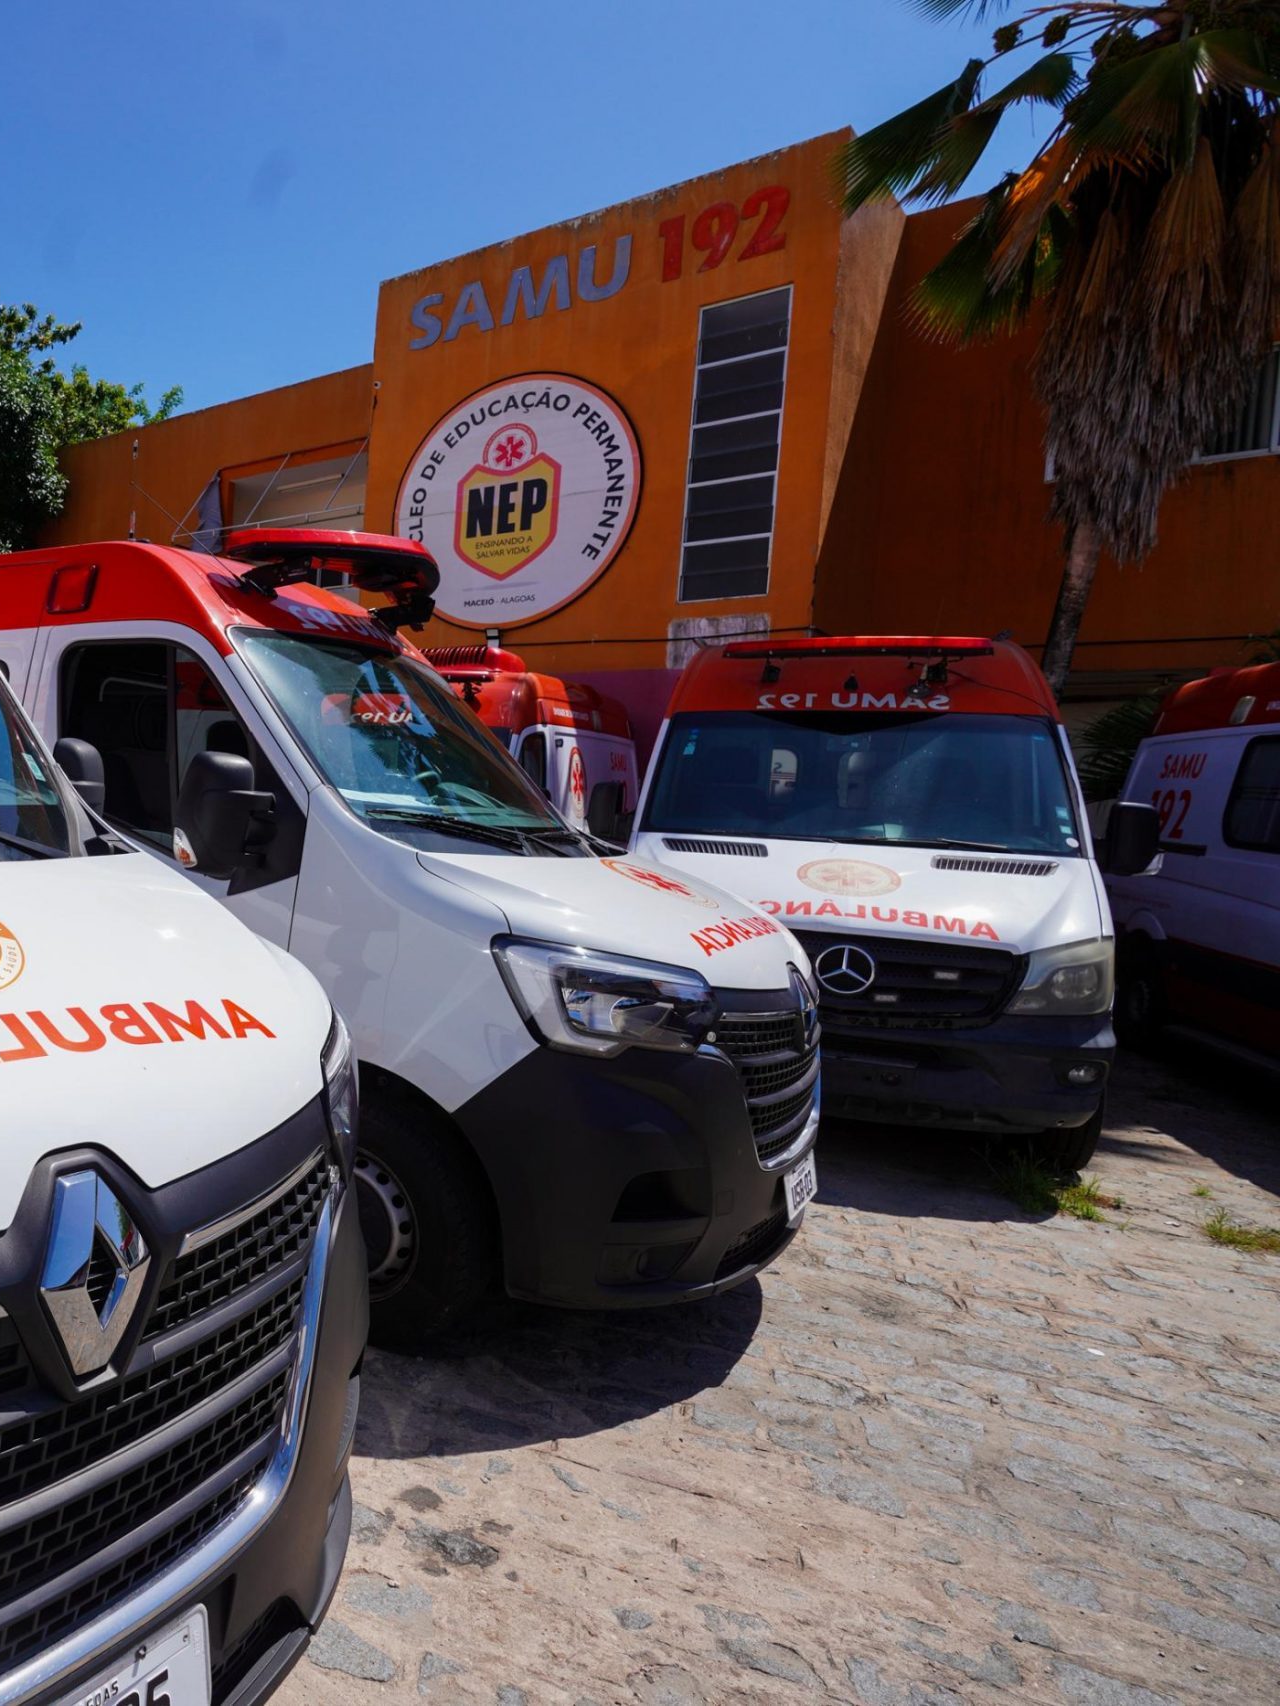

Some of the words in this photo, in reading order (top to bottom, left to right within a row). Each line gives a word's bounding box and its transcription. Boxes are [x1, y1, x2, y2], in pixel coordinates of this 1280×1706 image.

[409, 235, 632, 350] SAMU
[658, 184, 791, 283] 192
[409, 488, 427, 542] CLEO
[420, 449, 446, 481] DE
[443, 387, 571, 449] EDUCAÇÃO
[572, 402, 625, 561] PERMANENTE
[465, 478, 548, 538] NEP
[475, 536, 525, 550] ENSINANDO
[527, 535, 533, 543] A
[476, 548, 505, 559] SALVAR
[506, 545, 531, 556] VIDAS
[501, 594, 536, 605] ALAGOAS
[1158, 753, 1208, 779] SAMU
